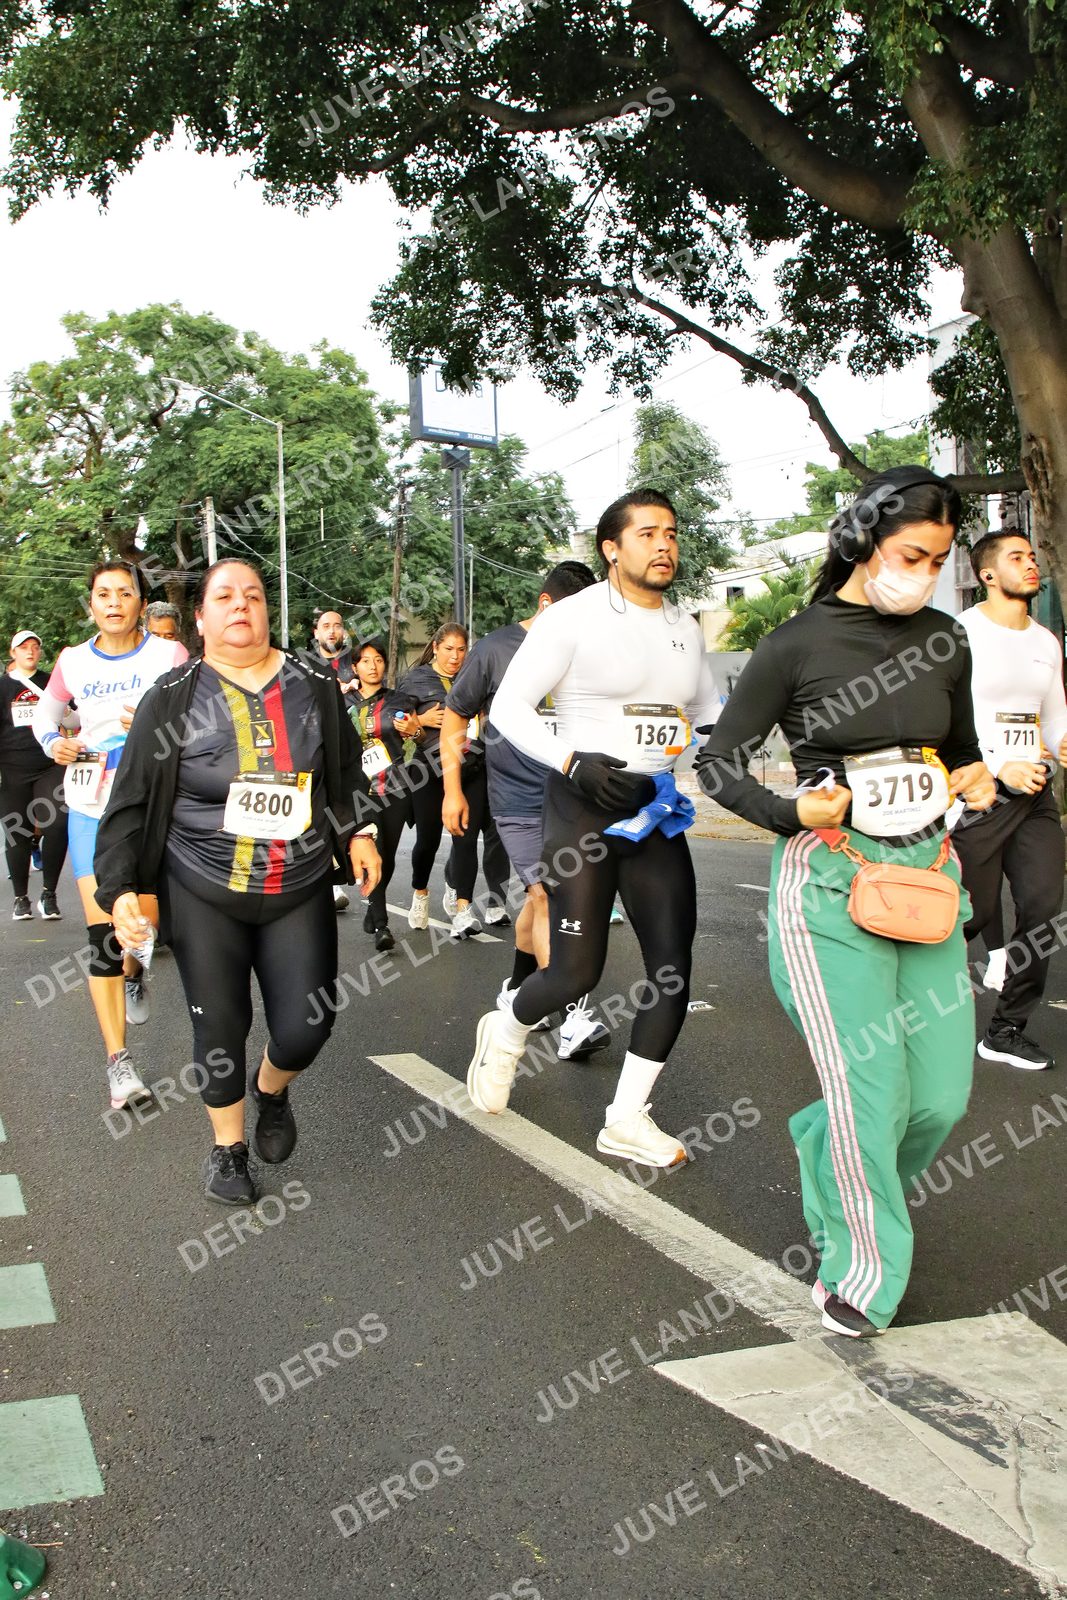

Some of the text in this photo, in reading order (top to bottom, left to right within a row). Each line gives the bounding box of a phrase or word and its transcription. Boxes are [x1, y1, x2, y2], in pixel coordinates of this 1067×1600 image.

[18, 709, 34, 719] 285
[635, 723, 679, 746] 1367
[1003, 729, 1035, 746] 1711
[71, 768, 93, 786] 417
[865, 772, 934, 808] 3719
[238, 790, 293, 817] 4800
